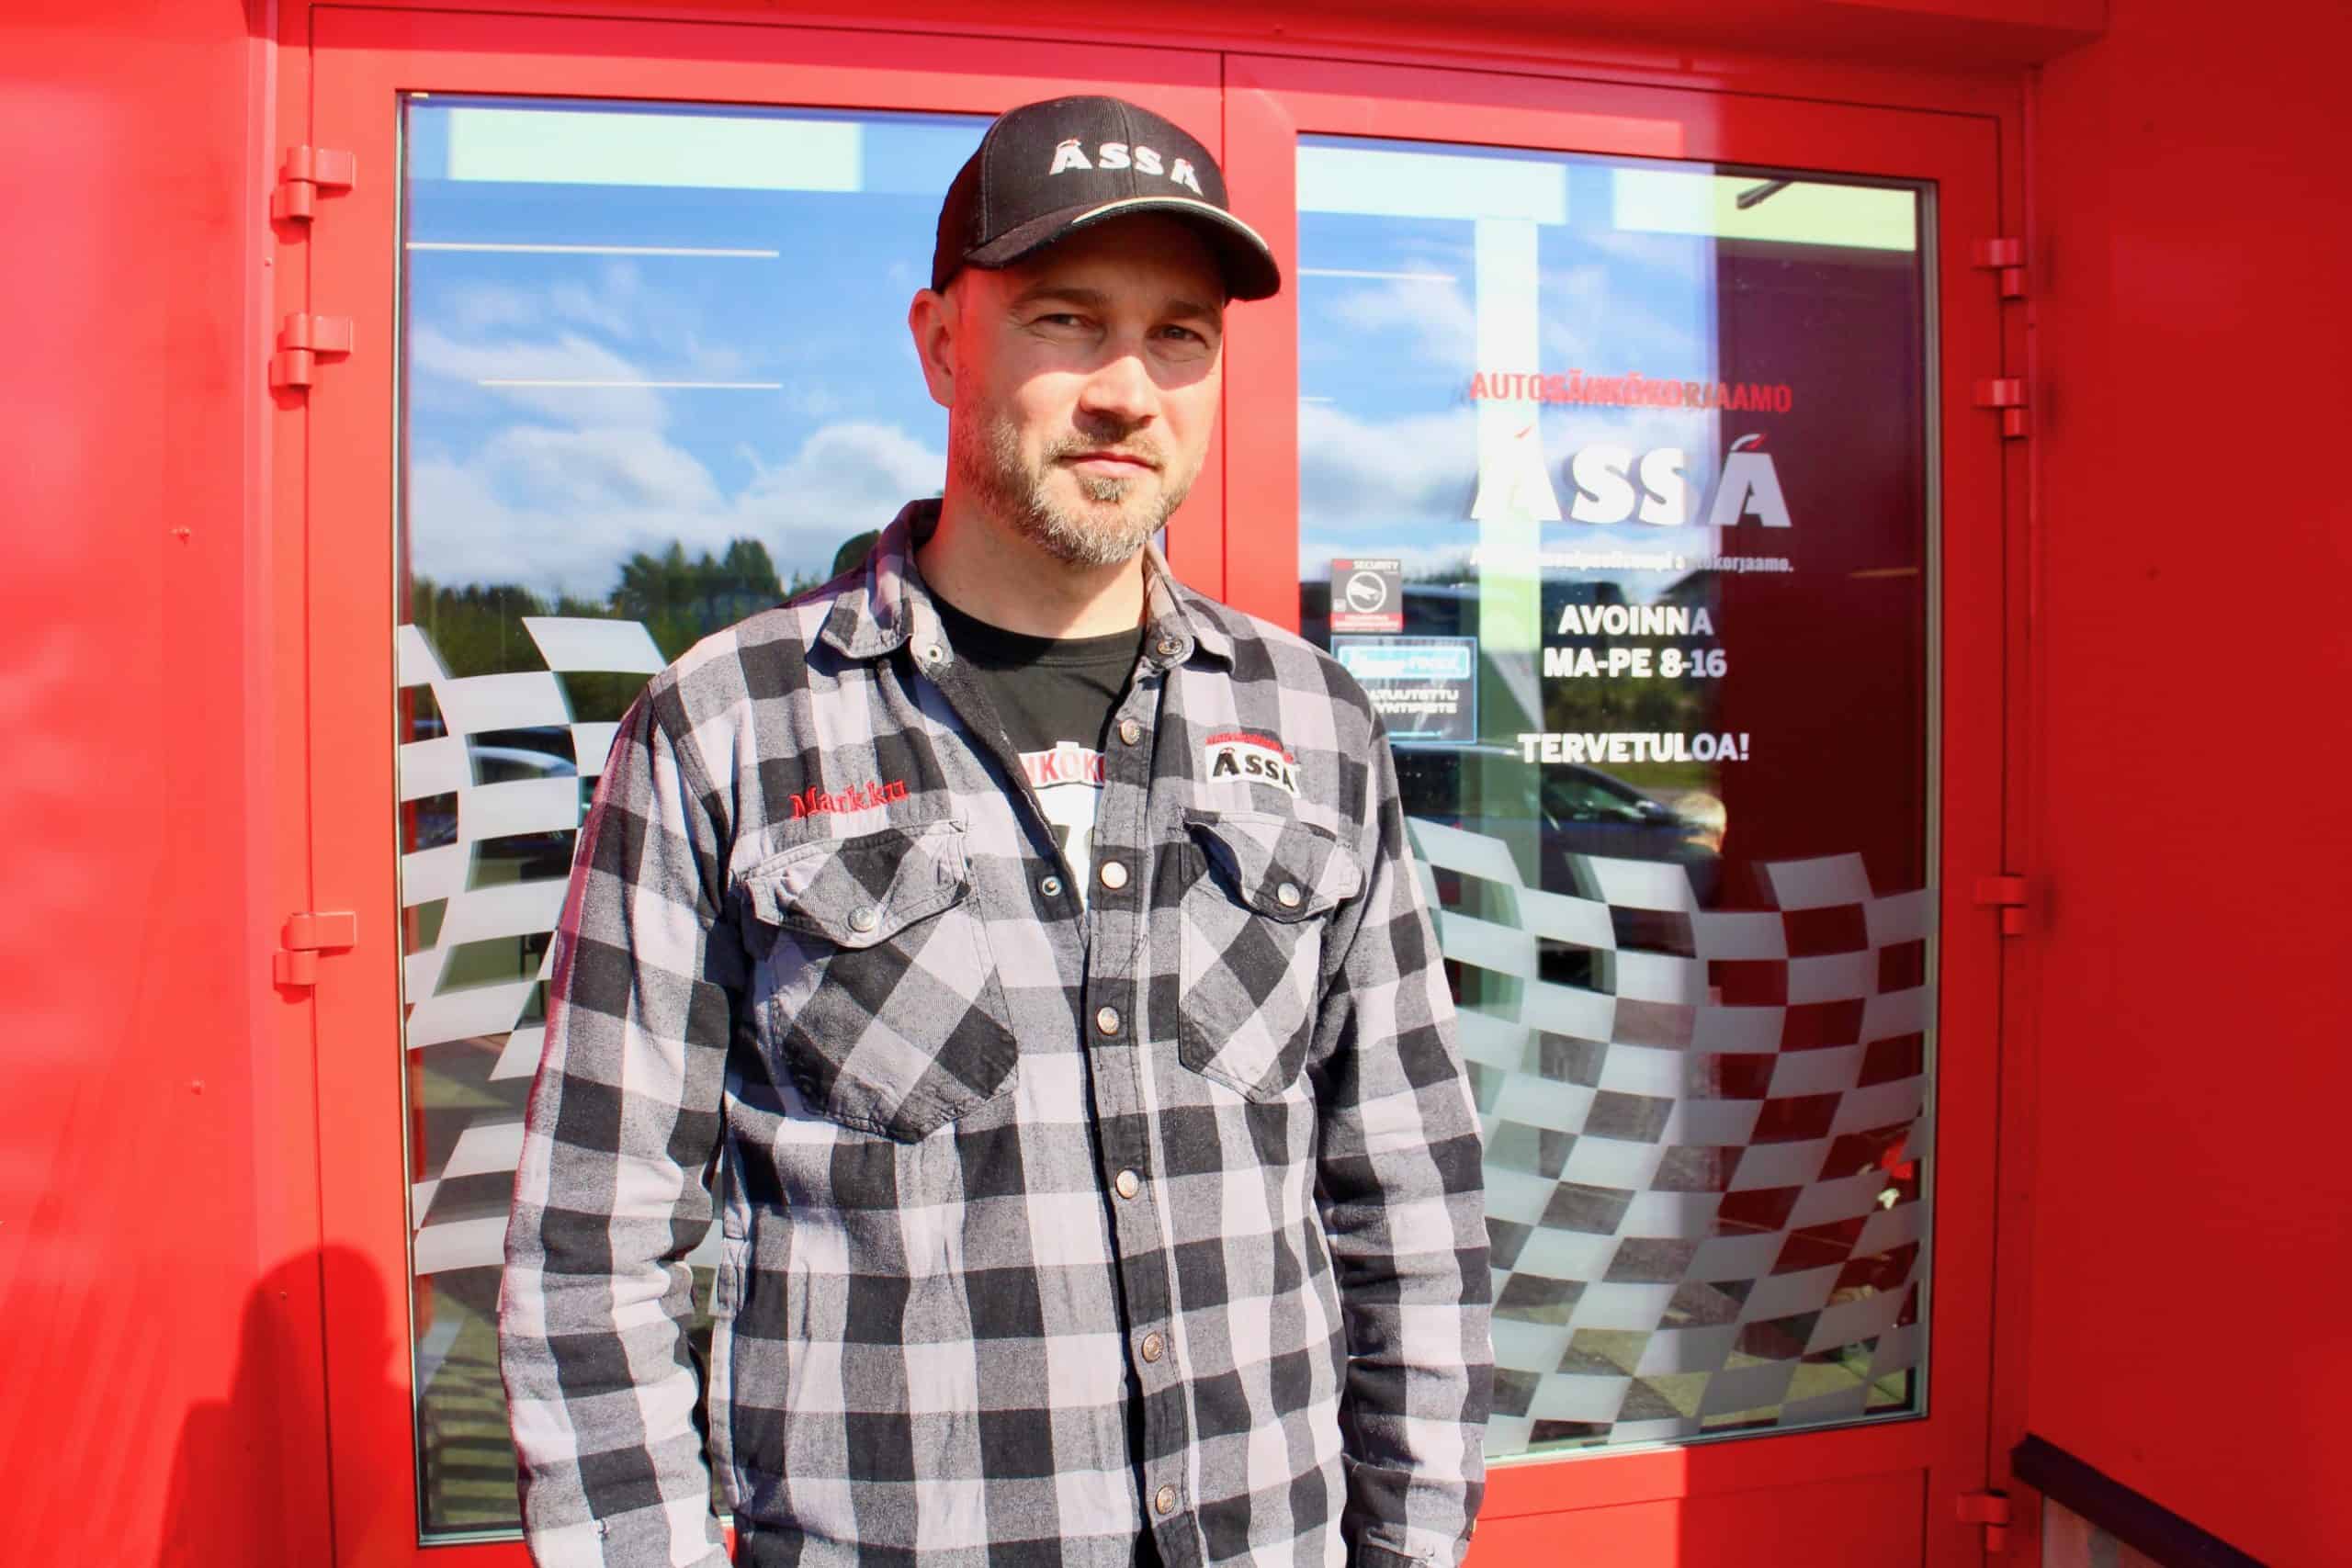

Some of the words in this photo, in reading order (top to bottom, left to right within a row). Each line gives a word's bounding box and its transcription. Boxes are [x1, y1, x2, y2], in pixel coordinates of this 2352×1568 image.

[1352, 560, 1399, 570] SECURITY
[1557, 604, 1713, 636] AVOINNA
[1544, 648, 1653, 678] MA-PE
[1658, 648, 1727, 678] 8-16
[1517, 732, 1750, 763] TERVETULOA!
[789, 779, 911, 820] Markku
